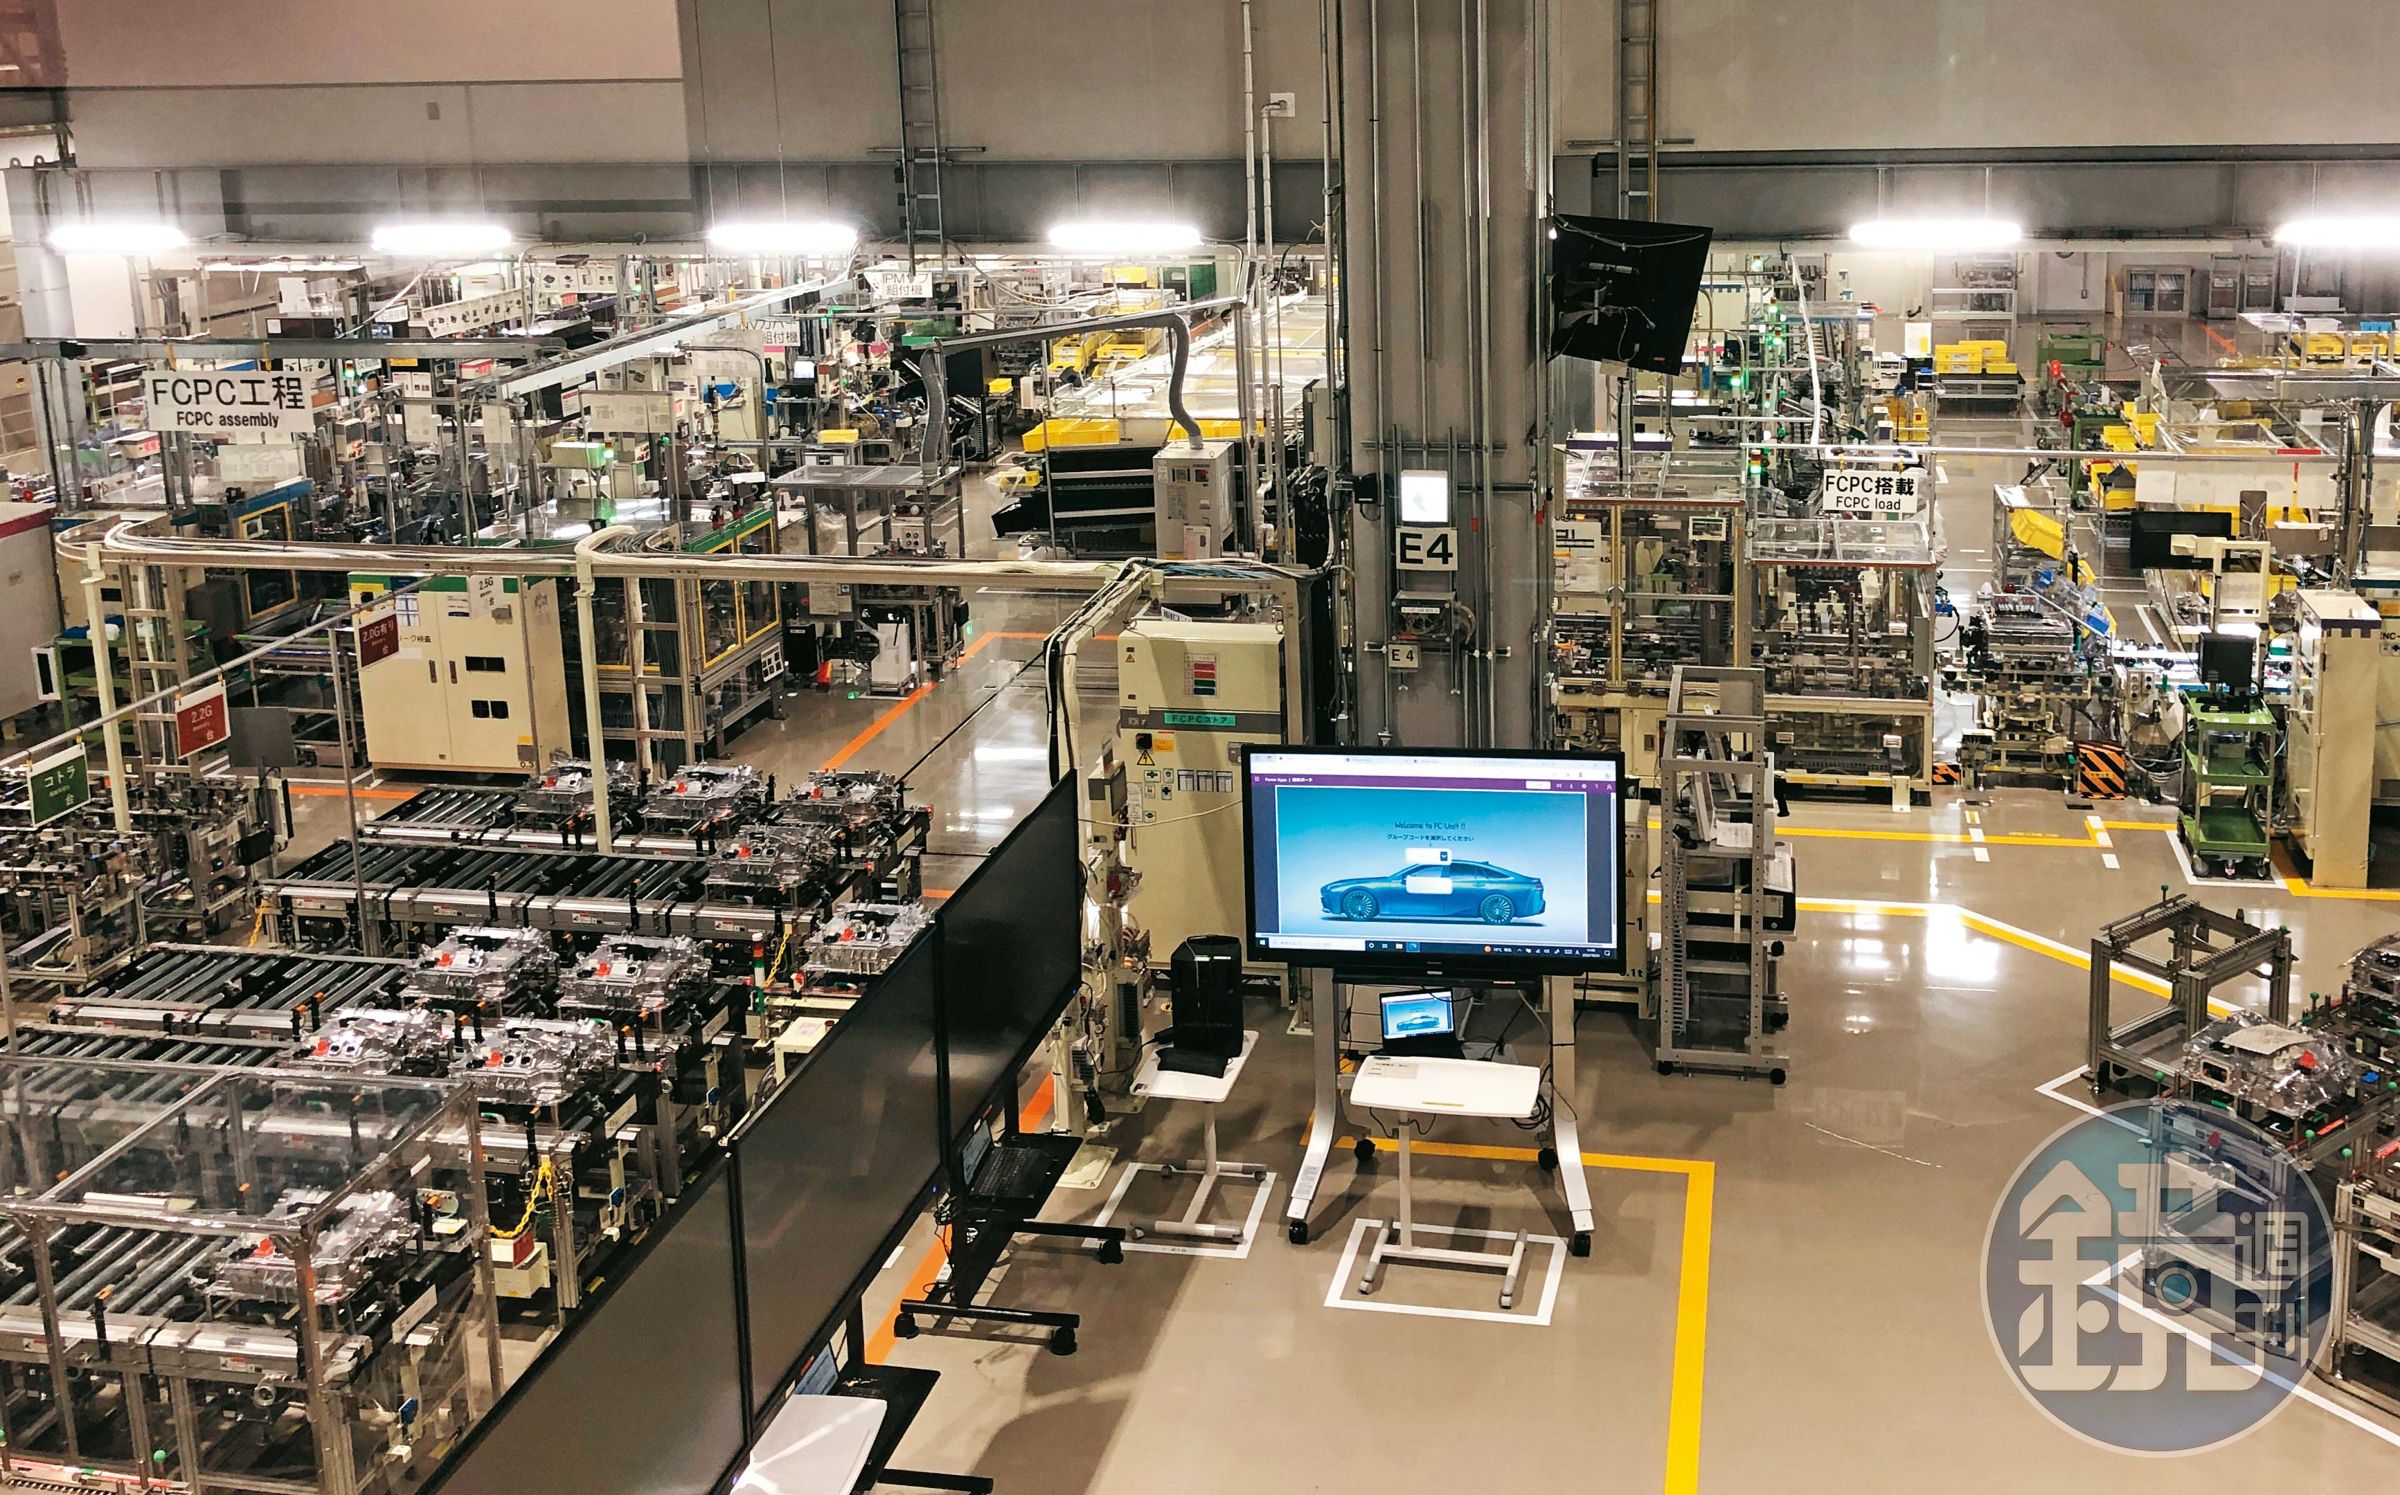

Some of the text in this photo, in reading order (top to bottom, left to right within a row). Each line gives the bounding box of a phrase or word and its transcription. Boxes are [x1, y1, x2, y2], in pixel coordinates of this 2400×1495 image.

[152, 376, 306, 410] FCPC工程
[177, 411, 279, 428] FCPC assembly
[1825, 475, 1914, 496] FCPC搭載
[1836, 496, 1901, 510] FCPC load
[1400, 532, 1453, 565] E4
[1171, 714, 1228, 725] FCPCストア
[44, 765, 76, 788] コトラ
[1394, 822, 1423, 830] Welcome
[1444, 823, 1459, 831] Unit
